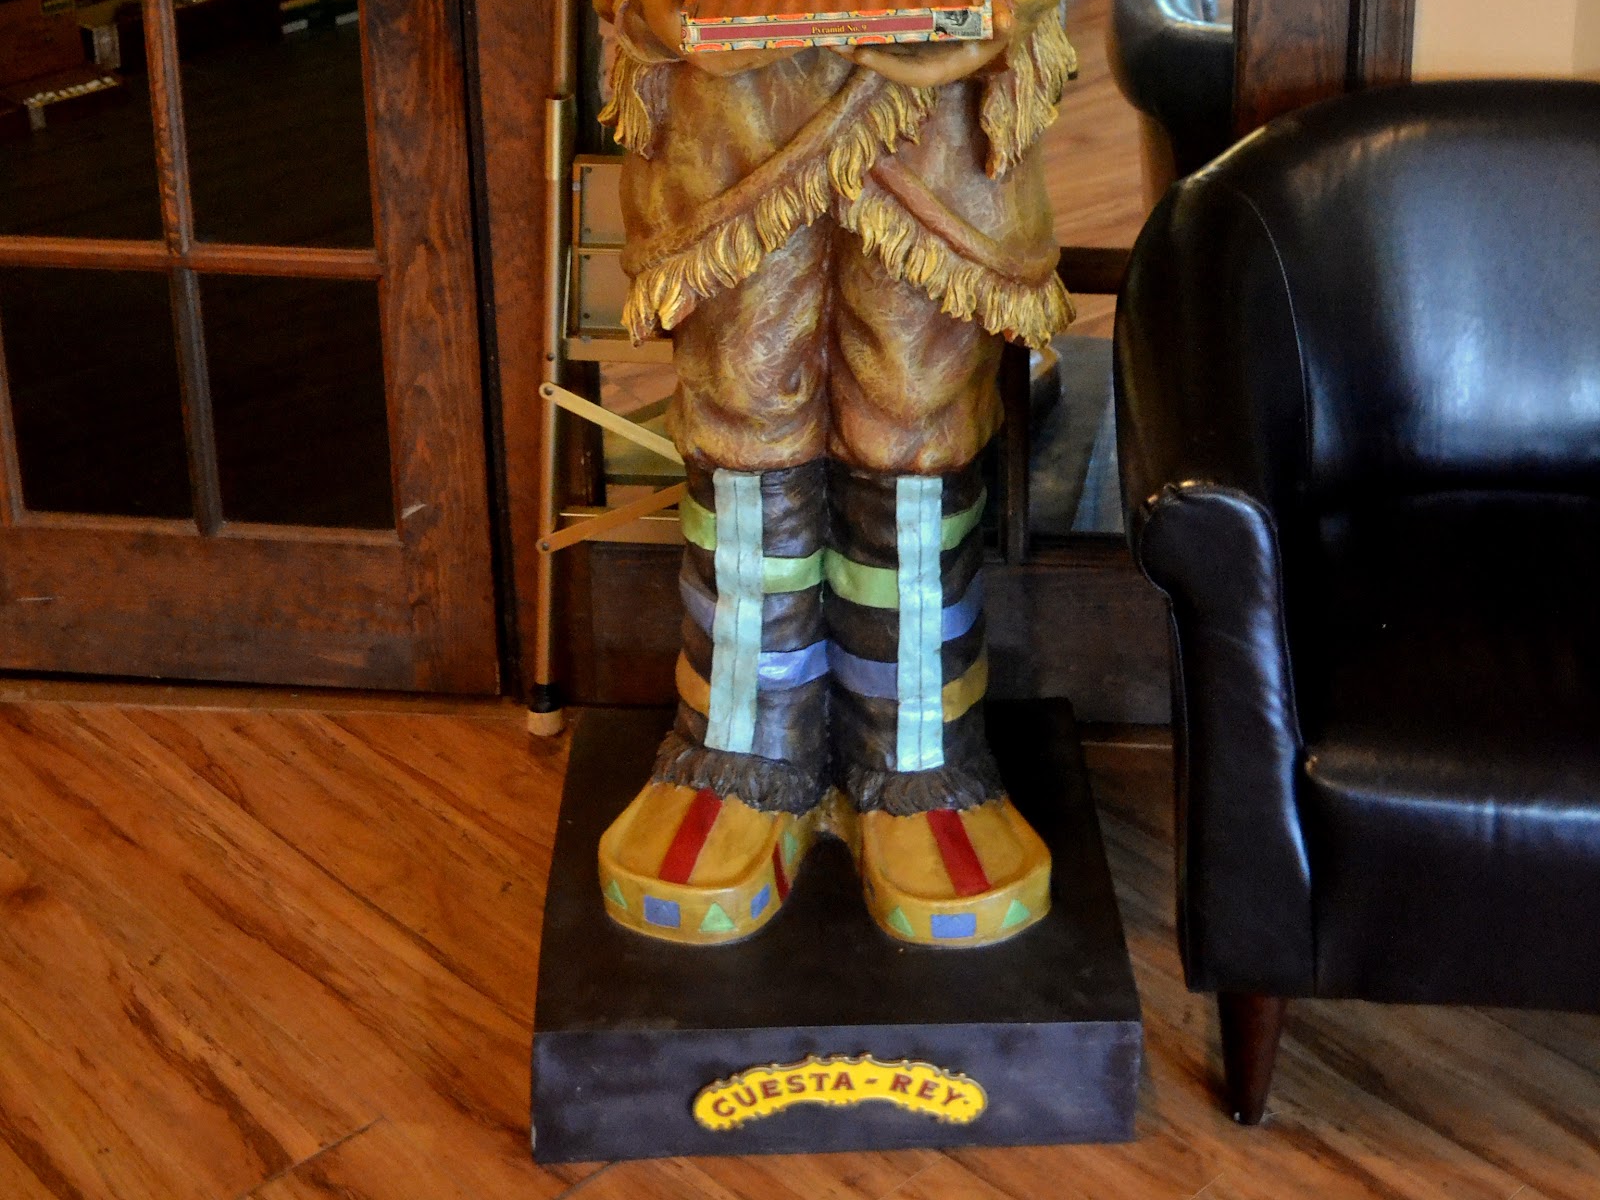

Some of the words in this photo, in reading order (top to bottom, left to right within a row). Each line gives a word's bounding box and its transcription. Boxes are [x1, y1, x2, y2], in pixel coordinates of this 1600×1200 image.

[811, 25, 845, 35] Pyramid
[847, 24, 861, 32] No.
[861, 23, 867, 31] 9
